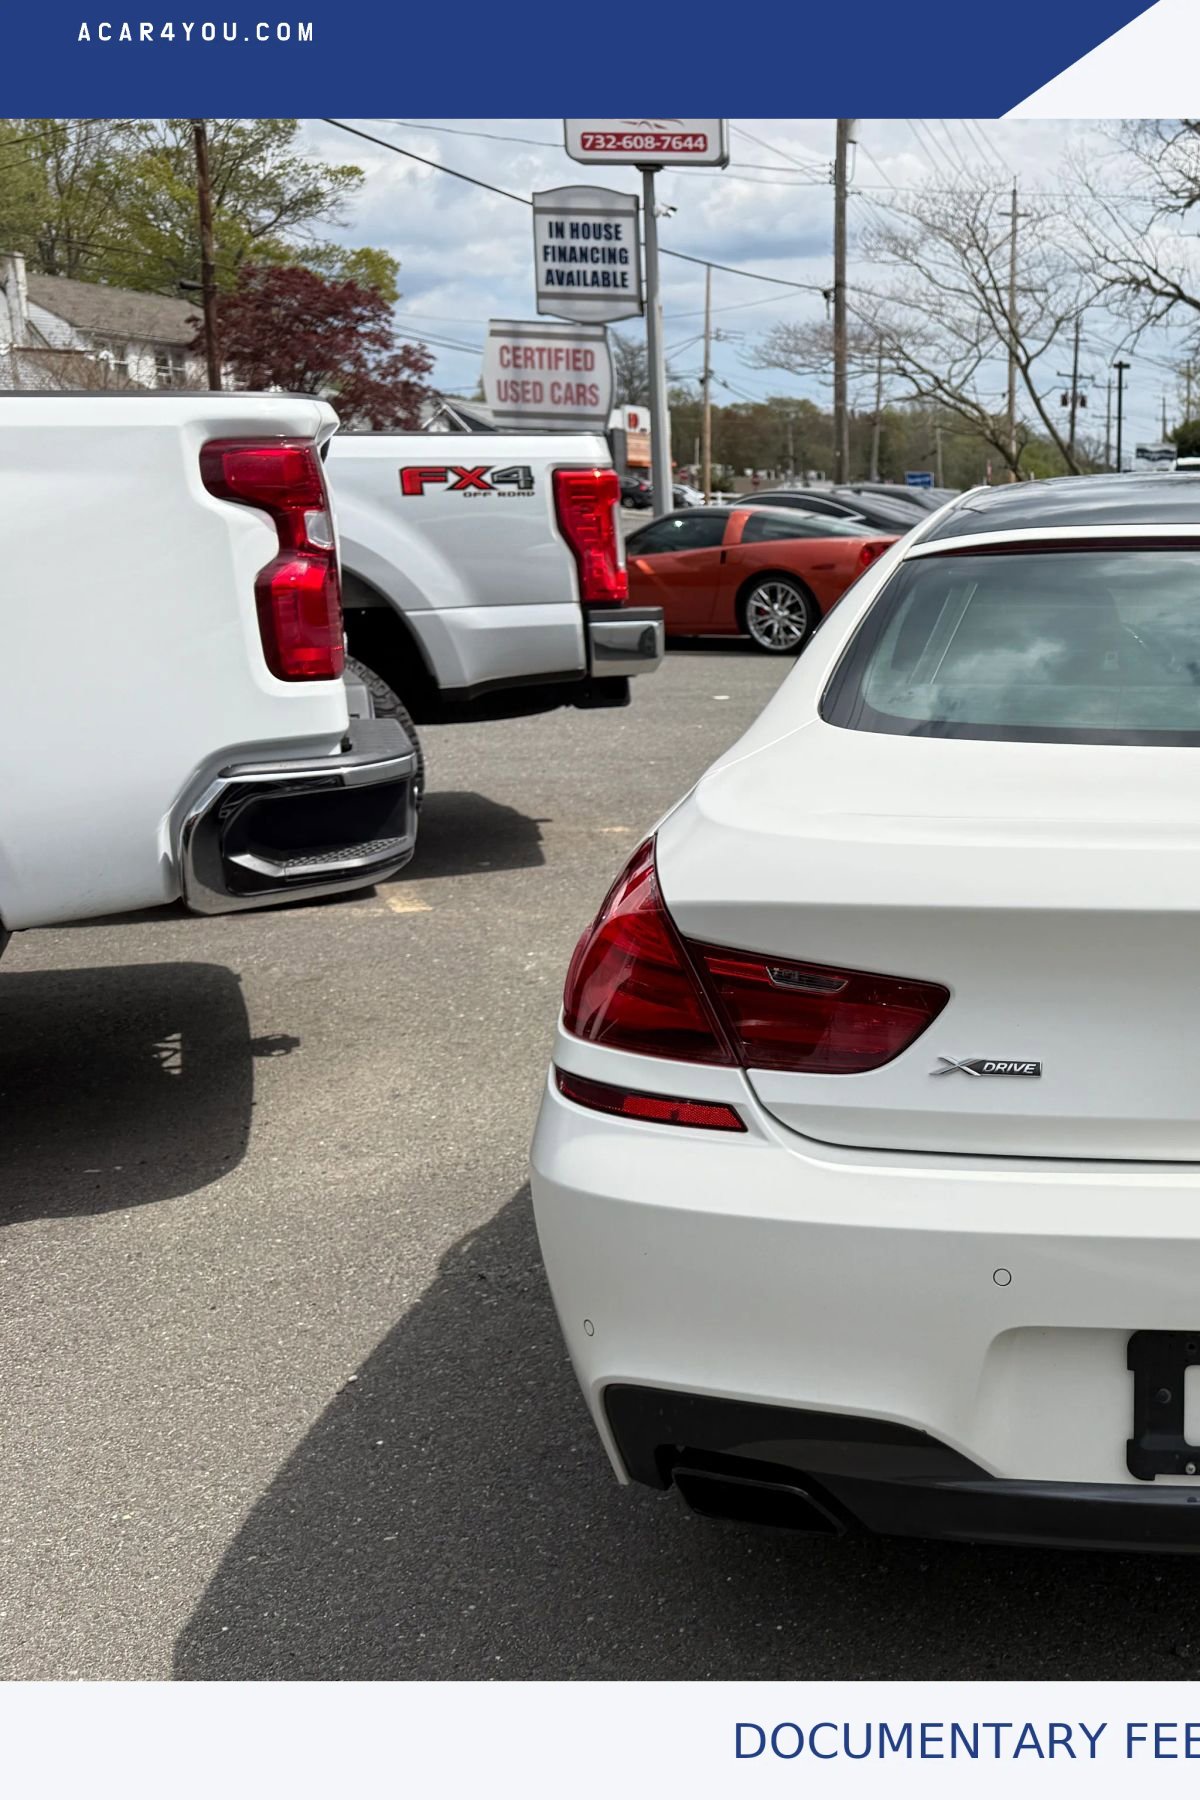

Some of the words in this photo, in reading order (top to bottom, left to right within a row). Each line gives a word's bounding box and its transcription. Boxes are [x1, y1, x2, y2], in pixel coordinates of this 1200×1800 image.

[583, 134, 705, 150] 732-608-7644
[548, 221, 565, 239] IN
[570, 222, 622, 241] HOUSE
[543, 245, 629, 265] FINANCING
[545, 269, 629, 288] AVAILABLE
[500, 346, 595, 371] CERTIFIED
[497, 380, 544, 404] USED
[551, 382, 599, 406] CARS
[399, 465, 535, 496] FX4
